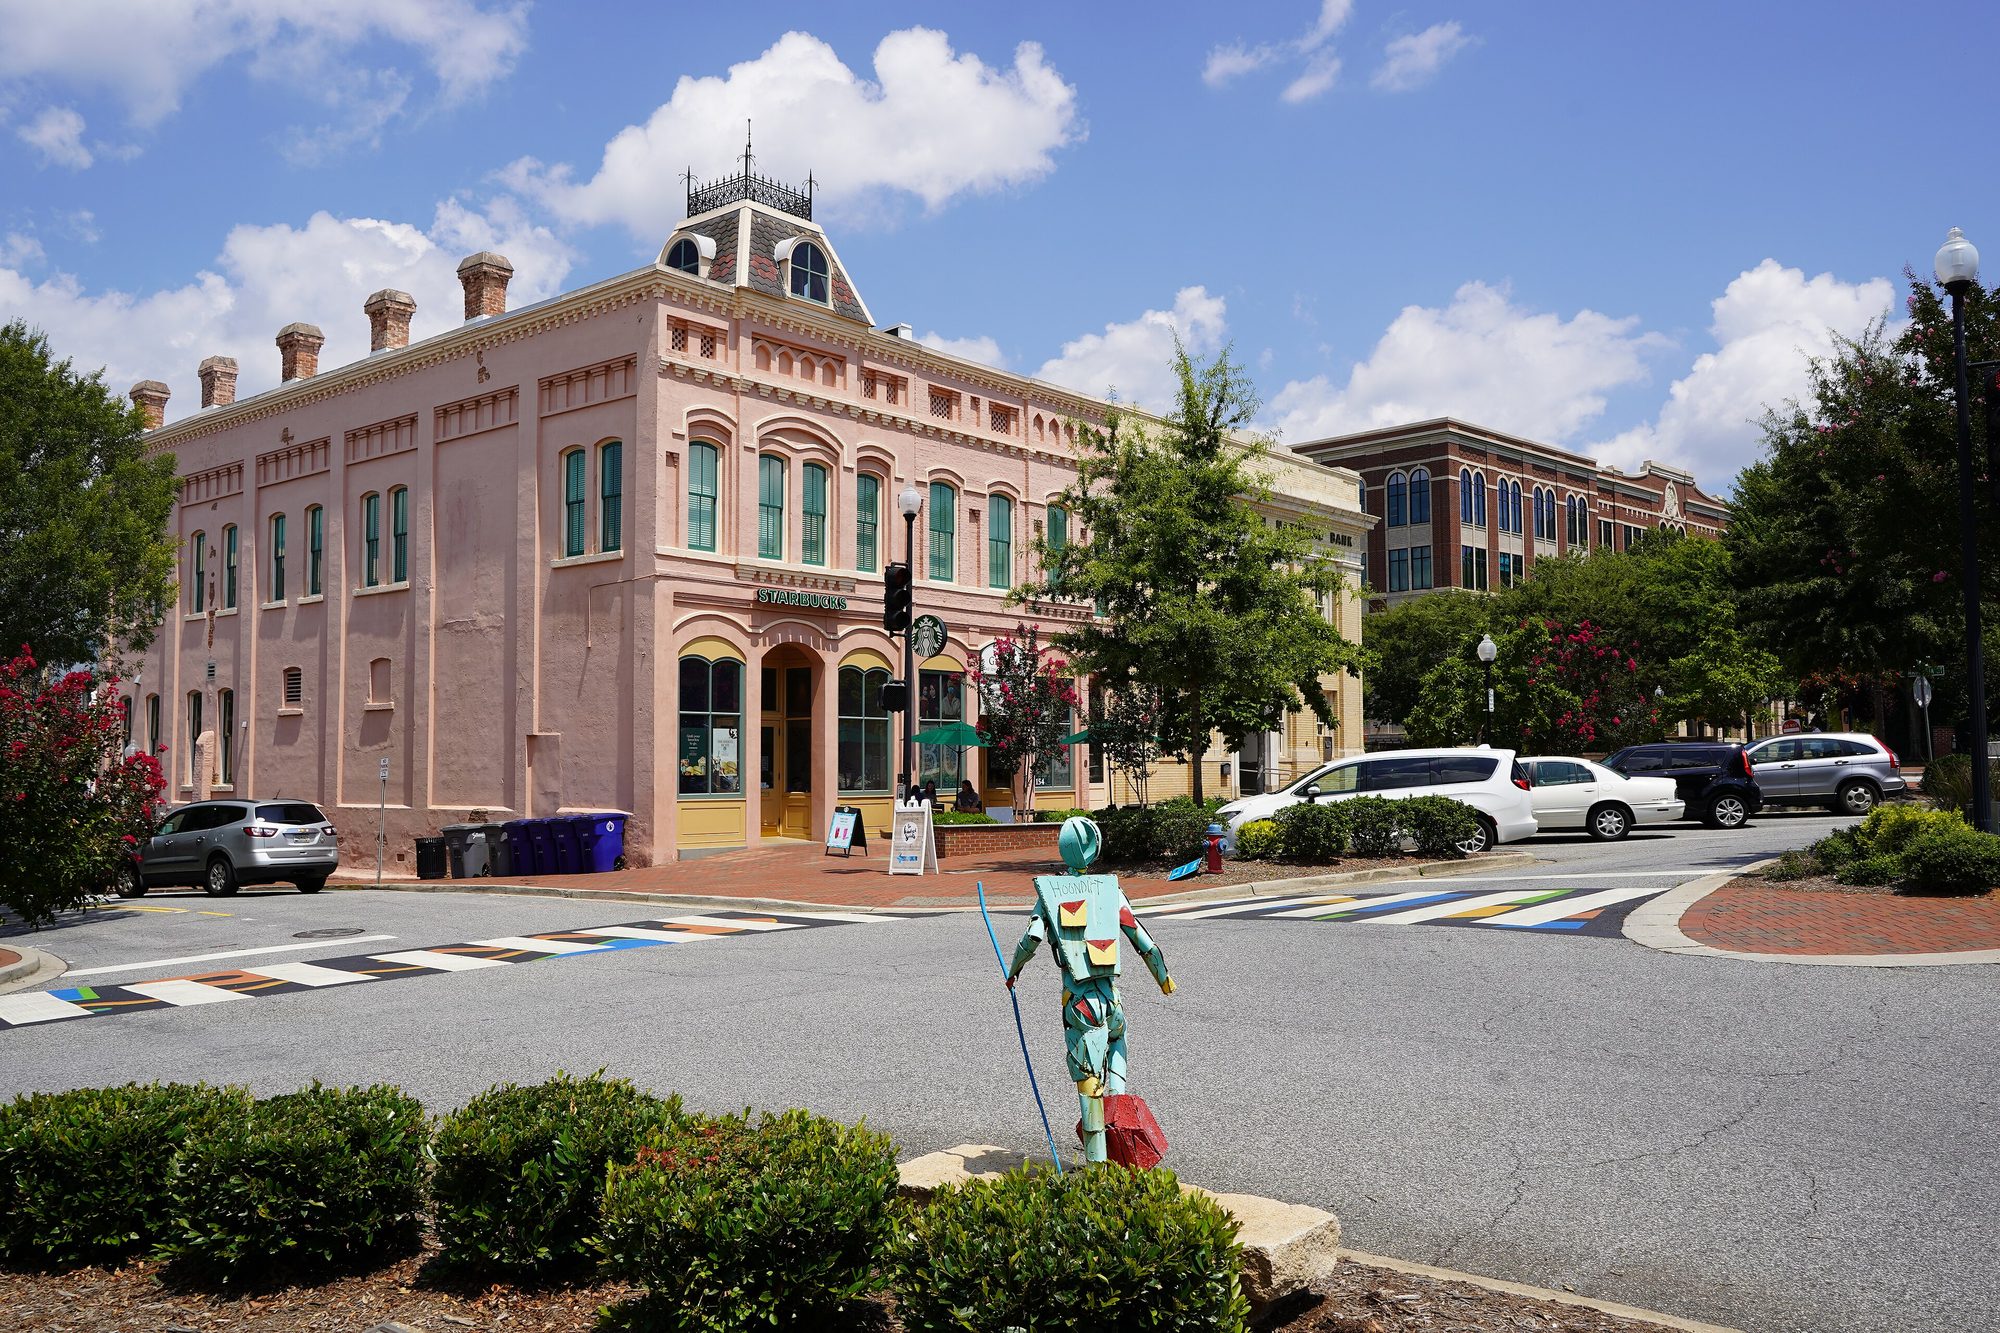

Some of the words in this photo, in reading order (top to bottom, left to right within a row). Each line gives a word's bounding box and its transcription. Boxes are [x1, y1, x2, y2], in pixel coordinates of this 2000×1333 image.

[1329, 532, 1353, 548] BANK
[758, 588, 848, 611] STARBUCKS
[1035, 777, 1045, 786] 154
